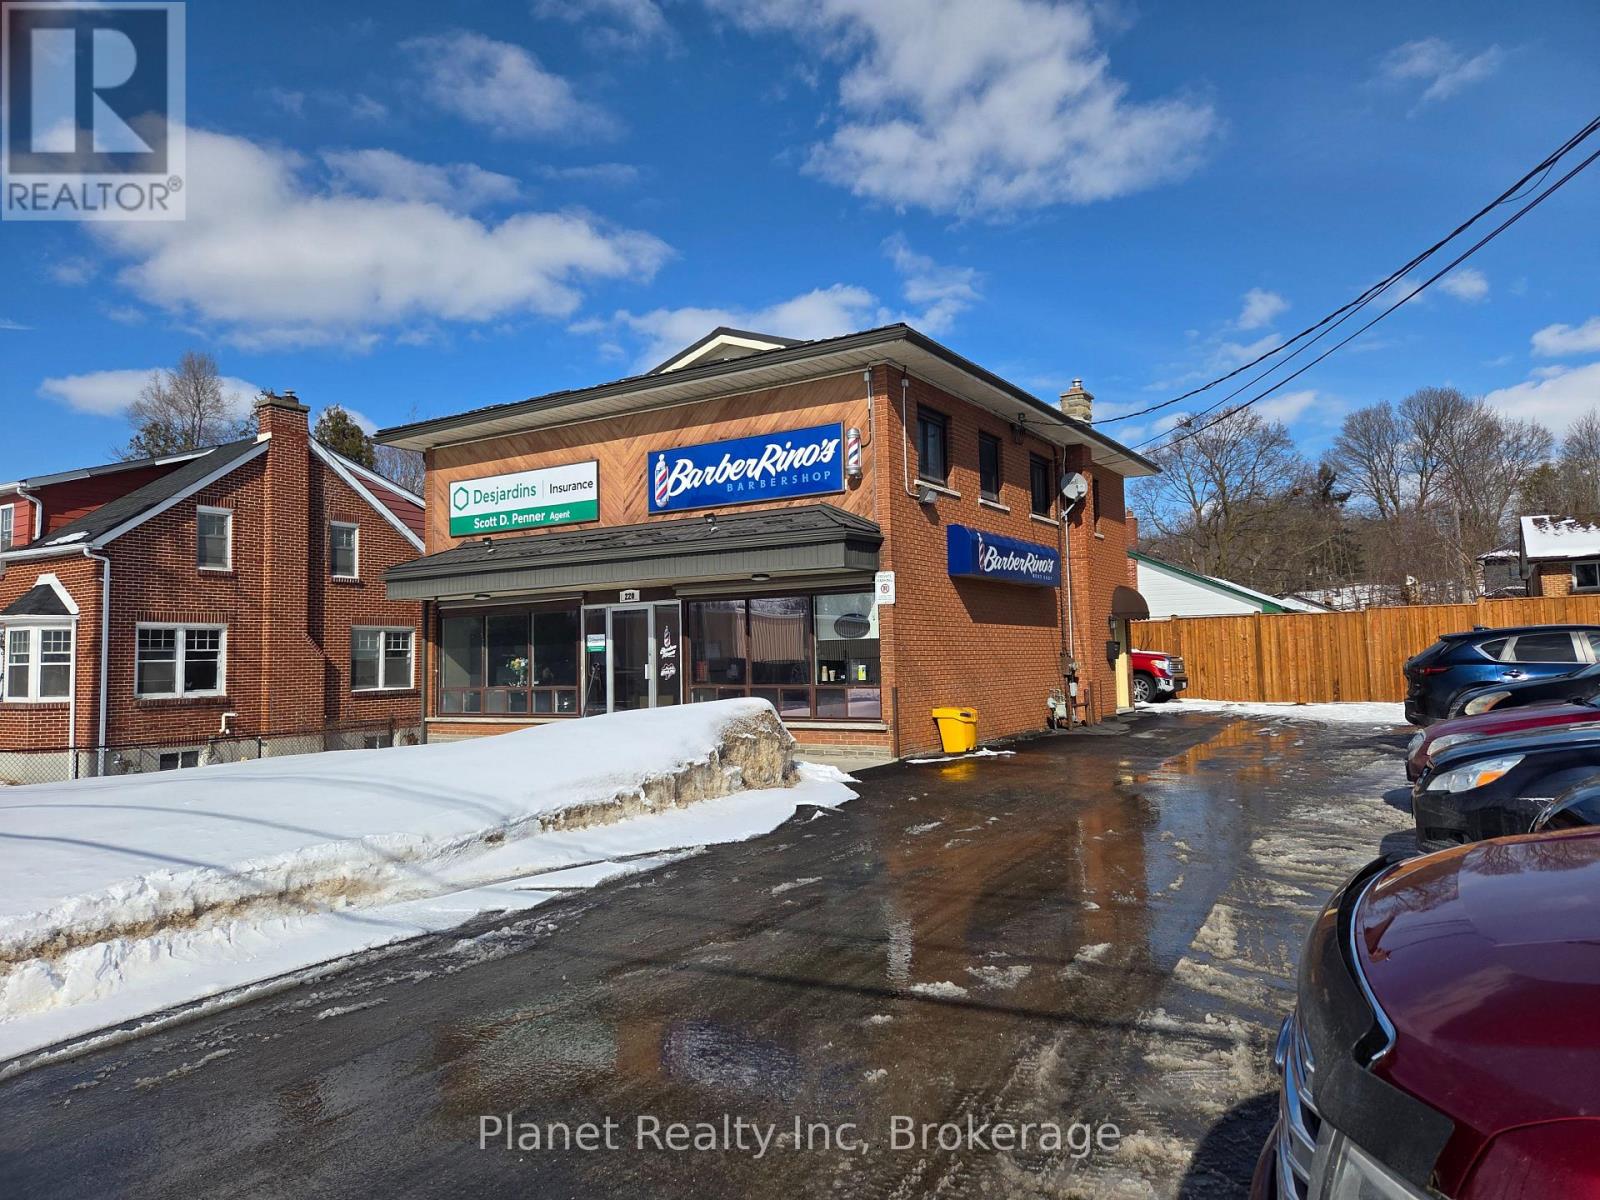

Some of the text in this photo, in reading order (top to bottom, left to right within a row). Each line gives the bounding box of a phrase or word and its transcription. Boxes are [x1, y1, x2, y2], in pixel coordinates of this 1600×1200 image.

[667, 438, 841, 497] BarberRino's
[473, 479, 594, 505] Desjardins Insurance
[726, 470, 832, 493] BARBERSHOP
[473, 510, 571, 530] Scott D. Penner Agent
[984, 545, 1055, 574] BarberRino's
